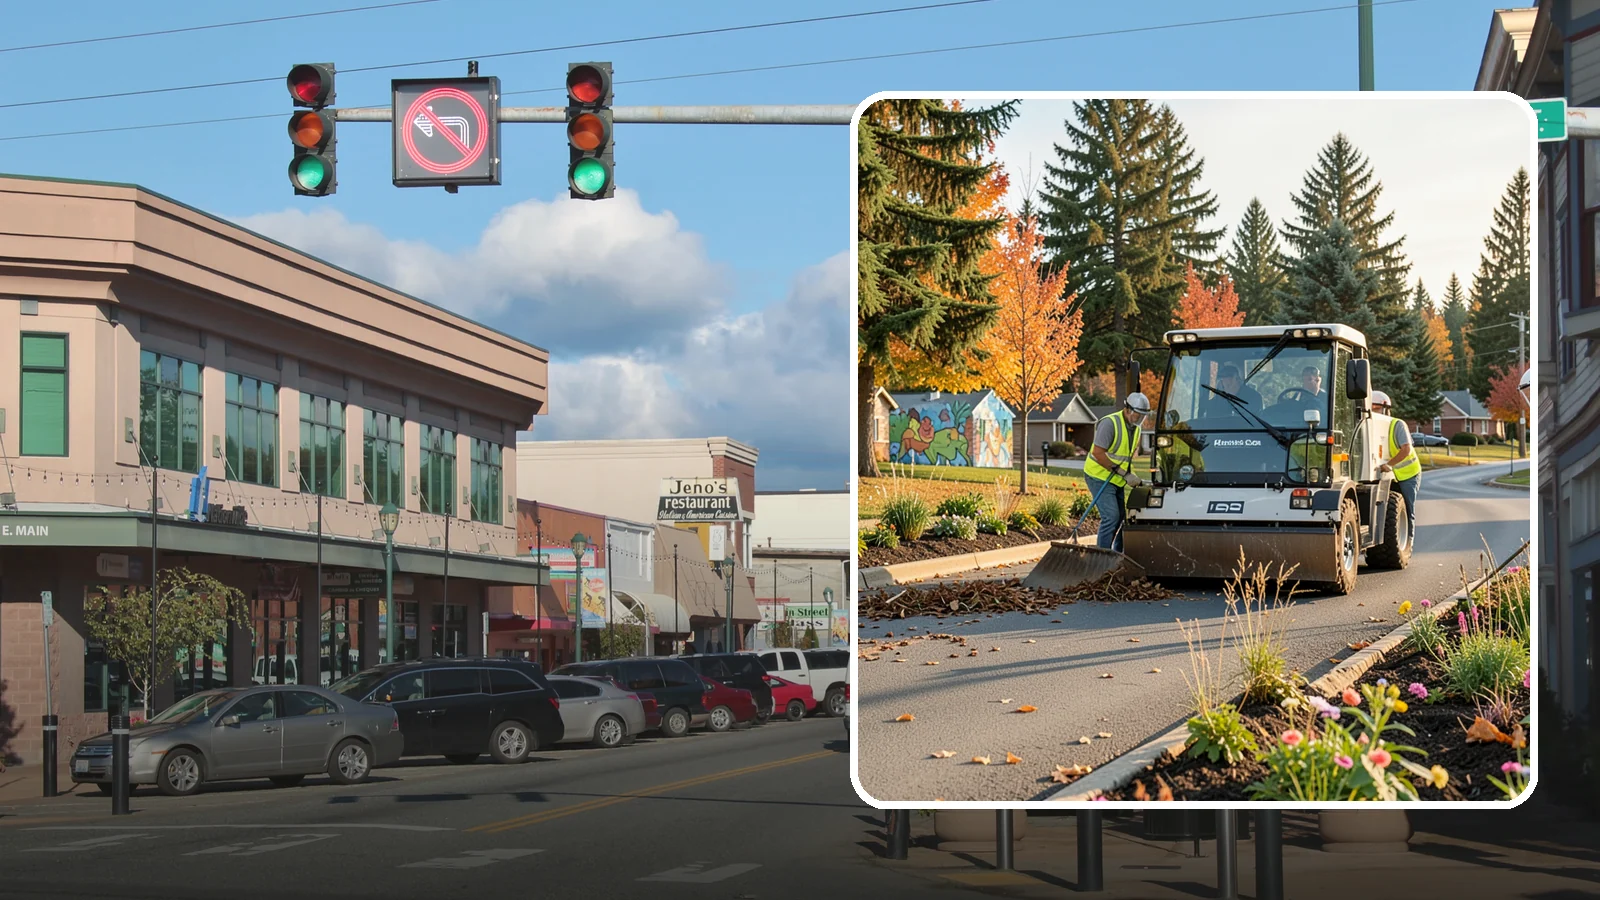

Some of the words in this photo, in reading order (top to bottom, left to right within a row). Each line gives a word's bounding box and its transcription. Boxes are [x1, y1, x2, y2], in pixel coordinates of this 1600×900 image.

[669, 480, 727, 494] Jeno's
[665, 497, 731, 509] restaurant
[659, 510, 681, 519] Italian
[686, 510, 714, 519] American
[715, 510, 738, 519] Cuisine
[2, 525, 13, 536] E.
[15, 525, 49, 536] MAIN
[797, 607, 829, 617] Street
[790, 619, 823, 627] lass
